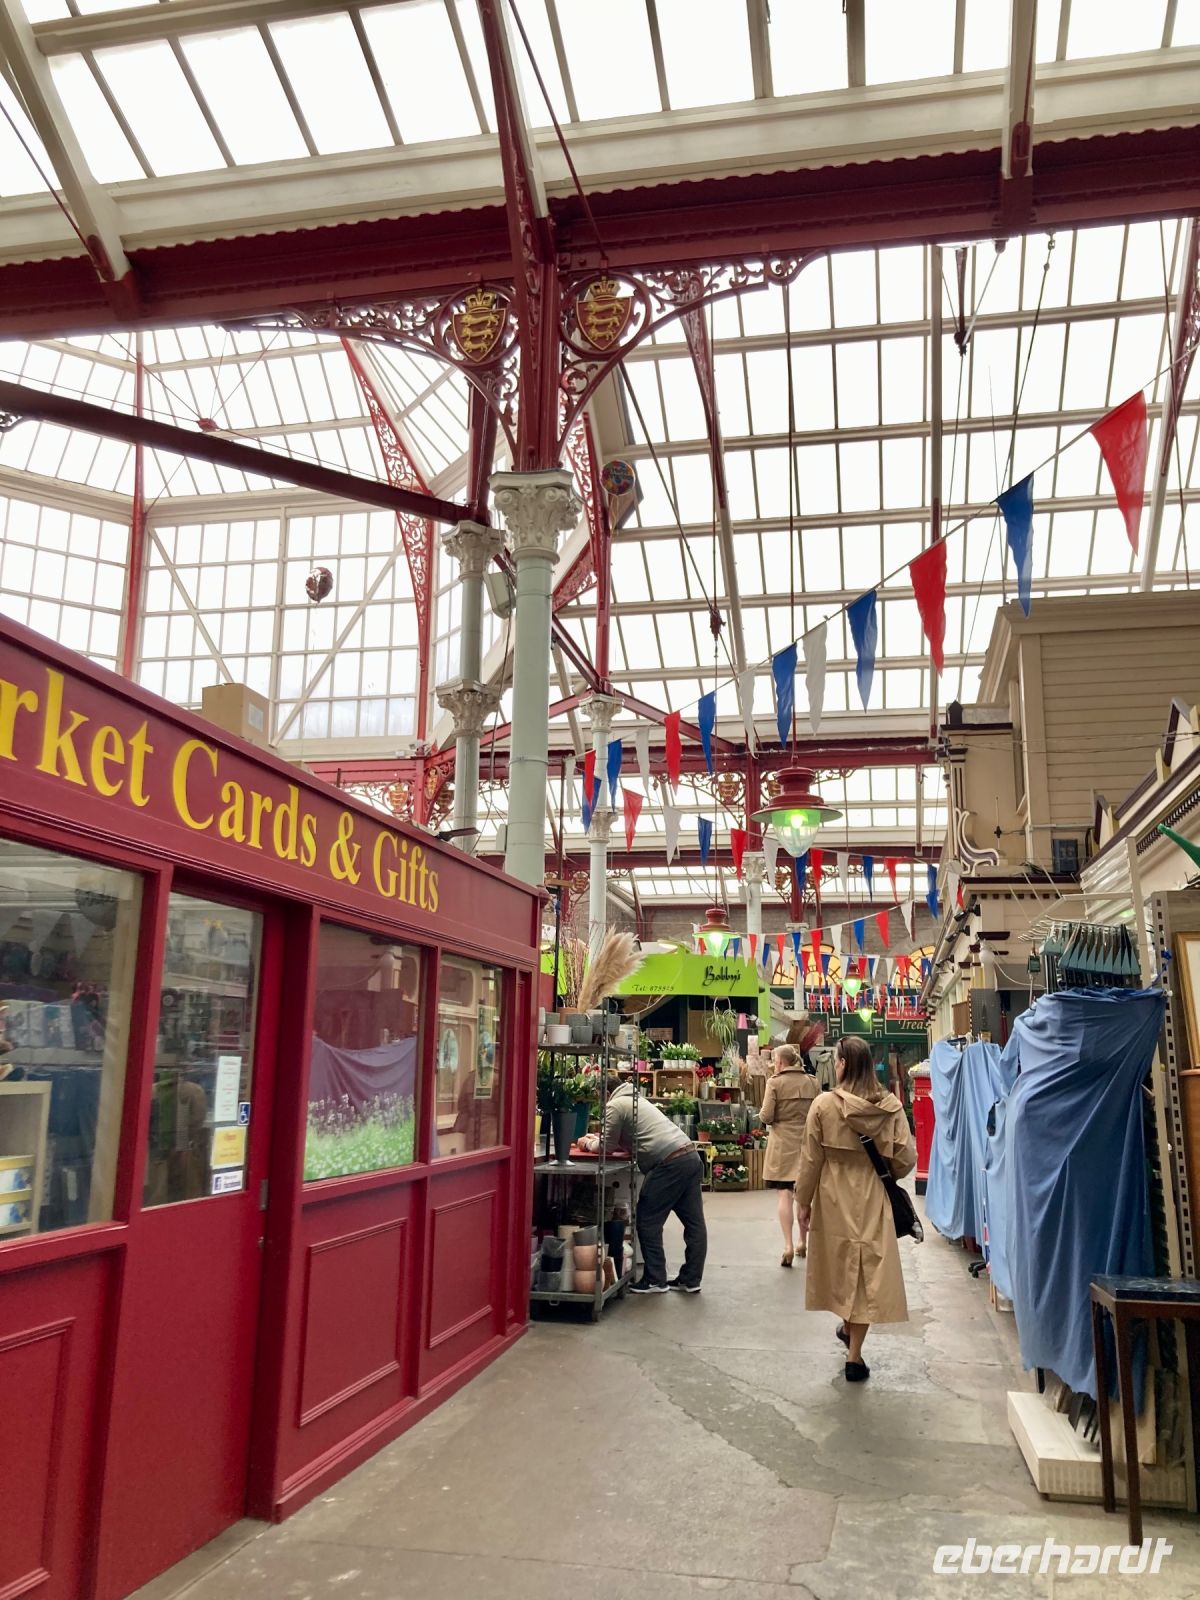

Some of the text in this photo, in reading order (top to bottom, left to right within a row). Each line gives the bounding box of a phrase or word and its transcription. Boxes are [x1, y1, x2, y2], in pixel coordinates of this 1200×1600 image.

[172, 738, 318, 868] Cards
[329, 811, 360, 885] &
[372, 830, 440, 914] Gifts
[702, 965, 742, 992] Bobby's
